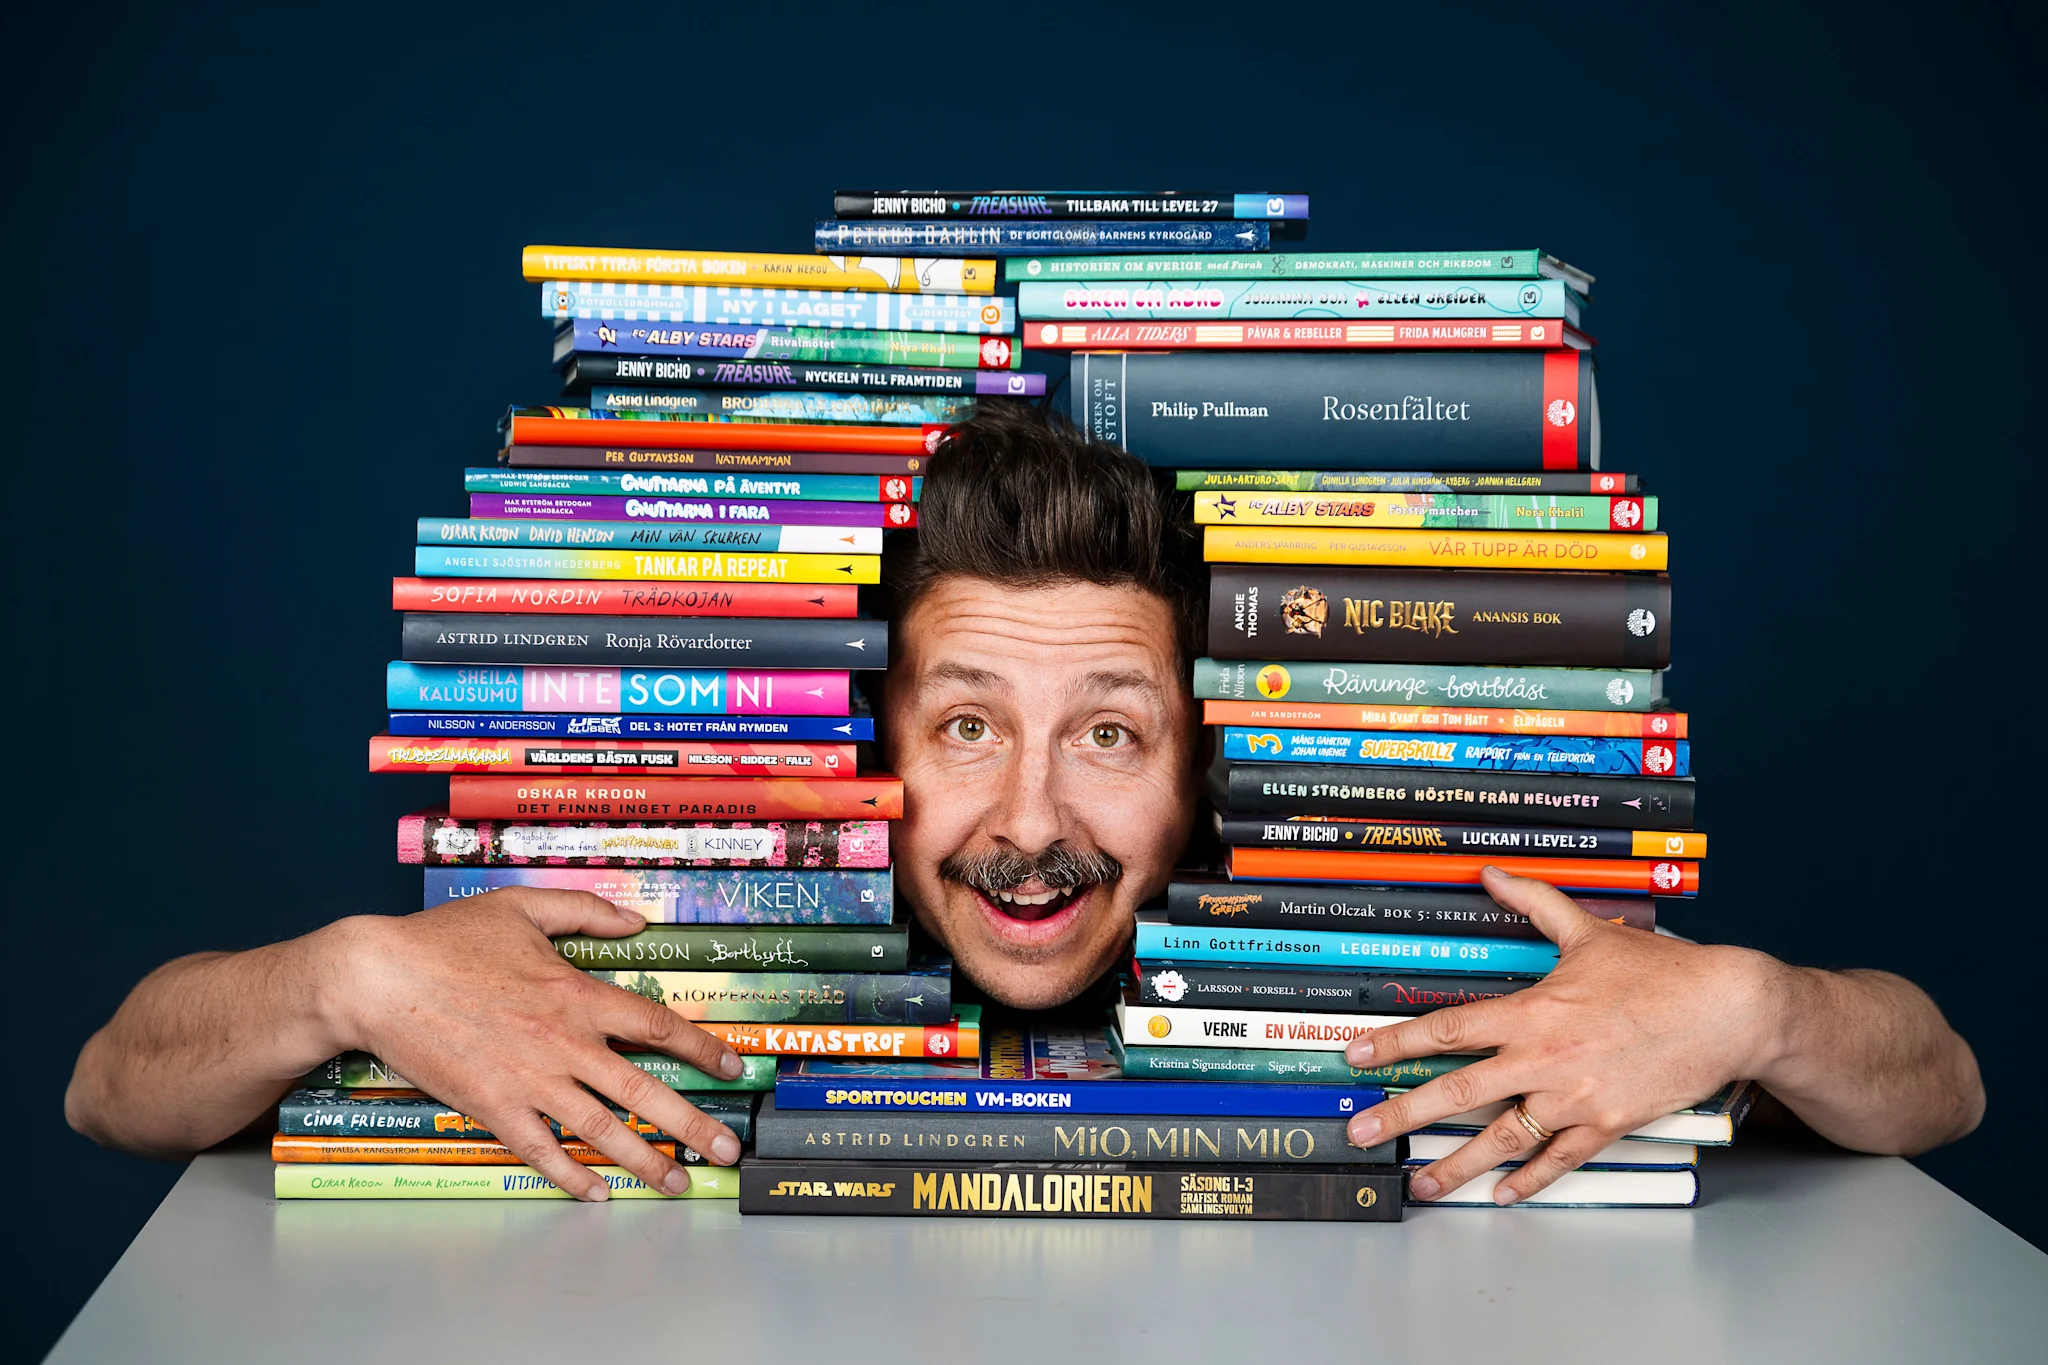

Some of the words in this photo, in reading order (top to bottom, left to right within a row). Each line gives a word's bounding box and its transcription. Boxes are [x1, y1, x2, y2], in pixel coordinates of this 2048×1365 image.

[872, 198, 909, 214] JENNY
[911, 197, 946, 214] BICHO
[968, 196, 1053, 214] TREASURE
[1066, 200, 1130, 213] TILLBAKA
[1132, 200, 1160, 213] TILL
[1162, 200, 1200, 213] LEVEL
[1202, 200, 1218, 213] 27
[1100, 231, 1146, 240] BARNENS
[1051, 262, 1120, 272] HISTORIEN
[1124, 262, 1143, 271] OM
[1147, 261, 1202, 271] SVERIGE
[1207, 261, 1229, 270] med
[1231, 260, 1263, 270] Farah
[1362, 260, 1414, 269] MASKINER
[1418, 260, 1440, 268] OCH
[1443, 259, 1492, 268] RIKEDOM
[723, 300, 758, 314] NY
[781, 302, 862, 318] LAGET
[646, 329, 695, 346] ALBY
[699, 331, 757, 349] STARS
[1248, 325, 1280, 339] PÅVAR
[1284, 328, 1291, 339] &
[1295, 327, 1341, 338] REBELLER
[1400, 327, 1429, 338] FRIDA
[1432, 327, 1486, 339] MALMGREN
[616, 360, 653, 377] JENNY
[656, 362, 691, 379] BICHO
[713, 364, 796, 384] TREASURE
[805, 370, 859, 385] NYCKELN
[862, 373, 887, 385] TILL
[890, 375, 962, 388] FRAMTIDEN
[1151, 401, 1199, 420] Philip
[1203, 402, 1268, 417] Pullman
[1322, 396, 1470, 421] Rosenfältet
[606, 451, 624, 462] PER
[629, 452, 694, 464] GUSTAVSSON
[714, 475, 737, 494] PÅ
[1505, 477, 1541, 487] HELLGREN
[728, 505, 770, 520] FARA
[1263, 500, 1313, 515] ALBY
[1315, 501, 1375, 517] STARS
[1516, 507, 1545, 517] Nora
[1548, 507, 1585, 518] Khalil
[1430, 536, 1465, 556] VÅR
[1472, 542, 1518, 557] TUPP
[1523, 541, 1548, 559] ÄR
[1555, 541, 1598, 559] DÖD
[634, 555, 698, 577] TANKAR
[702, 553, 722, 577] PÅ
[727, 557, 788, 579] REPEAT
[431, 586, 497, 603] SOFIA
[511, 588, 602, 605] NORDIN
[1235, 593, 1244, 631] ANGIE
[1248, 586, 1258, 638] THOMAS
[1344, 598, 1384, 634] NIC
[1390, 600, 1459, 639] BLAKE
[1473, 612, 1529, 624] ANANSIS
[1533, 612, 1562, 625] BOK
[437, 632, 498, 644] ASTRID
[504, 634, 589, 646] LINDGREN
[606, 634, 651, 652] Ronja
[657, 633, 752, 650] Rövardotter
[457, 670, 518, 685] SHEILA
[1218, 667, 1230, 695] Frida
[1235, 664, 1245, 698] Nilsson
[420, 686, 517, 702] KALUSUMU
[531, 671, 612, 704] INTE
[628, 674, 719, 706] SOM
[737, 676, 773, 708] NI
[428, 720, 475, 729] NILSSON
[489, 721, 555, 730] ANDERSSON
[630, 722, 650, 731] DEL
[653, 722, 664, 731] 3:
[667, 722, 703, 732] HOTET
[706, 721, 736, 733] FRÅN
[739, 723, 788, 733] RYMDEN
[1291, 735, 1314, 745] MÅNS
[530, 752, 594, 764] VÄRLDENS
[597, 752, 637, 764] BÄSTA
[641, 754, 673, 764] FUSK
[688, 754, 733, 765] NILSSON
[740, 755, 778, 765] RIDDEZ
[786, 756, 812, 766] FALK
[1291, 747, 1316, 755] JOHAN
[517, 788, 577, 799] OSKAR
[586, 788, 646, 799] KROON
[1263, 783, 1307, 797] ELLEN
[1312, 785, 1406, 801] STRÖMBERG
[1415, 787, 1474, 802] HÖSTEN
[1479, 790, 1520, 804] FRÅN
[1524, 793, 1599, 807] HELVETET
[517, 804, 550, 813] DET
[558, 804, 611, 814] FINNS
[619, 804, 670, 814] INGET
[680, 805, 757, 814] PARADIS
[705, 838, 763, 851] KINNEY
[1262, 825, 1300, 841] JENNY
[1302, 826, 1338, 842] BICHO
[1361, 826, 1447, 846] TREASURE
[1462, 832, 1523, 845] LUCKAN
[1525, 833, 1530, 846] I
[1534, 833, 1577, 848] LEVEL
[1579, 836, 1598, 848] 23
[579, 843, 597, 851] fans
[718, 882, 819, 908] VIKEN
[1280, 902, 1325, 915] Martin
[1330, 903, 1376, 917] Olczak
[1384, 908, 1412, 919] BOK
[1417, 910, 1430, 921] 5:
[1436, 910, 1477, 922] SKRIK
[1482, 912, 1499, 922] AV
[1164, 937, 1199, 949] Linn
[1210, 938, 1320, 953] Gottfridsson
[1341, 943, 1421, 957] LEGENDEN
[1431, 946, 1450, 958] OM
[1459, 947, 1489, 959] OSS
[1198, 984, 1241, 993] LARSSON
[1253, 986, 1296, 995] KORSELL
[1306, 988, 1352, 997] JONSSON
[1204, 1021, 1247, 1037] VERNE
[1265, 1023, 1285, 1039] EN
[766, 1028, 906, 1055] KATASTROF
[1149, 1058, 1189, 1070] Kristina
[1192, 1059, 1255, 1072] Sigunsdotter
[1268, 1061, 1296, 1073] Signe
[1298, 1061, 1322, 1075] Kjær
[825, 1090, 967, 1106] SPORTTOUCHEN
[975, 1092, 1072, 1107] VM-BOKEN
[805, 1132, 892, 1145] ASTRID
[903, 1134, 1025, 1147] LINDGREN
[1147, 1127, 1220, 1158] MIN
[1237, 1128, 1314, 1159] MIO
[311, 1177, 345, 1188] OSKAR
[348, 1177, 383, 1188] KROON
[394, 1177, 432, 1188] HANNA
[1181, 1173, 1231, 1192] SÄSONG
[770, 1181, 832, 1196] STAR
[834, 1183, 896, 1197] WARS
[913, 1172, 1152, 1213] MANDALORIERN
[1181, 1193, 1219, 1204] GRAFISK
[1221, 1194, 1253, 1204] ROMAN
[1181, 1203, 1253, 1214] SAMLINGSVOLYM
